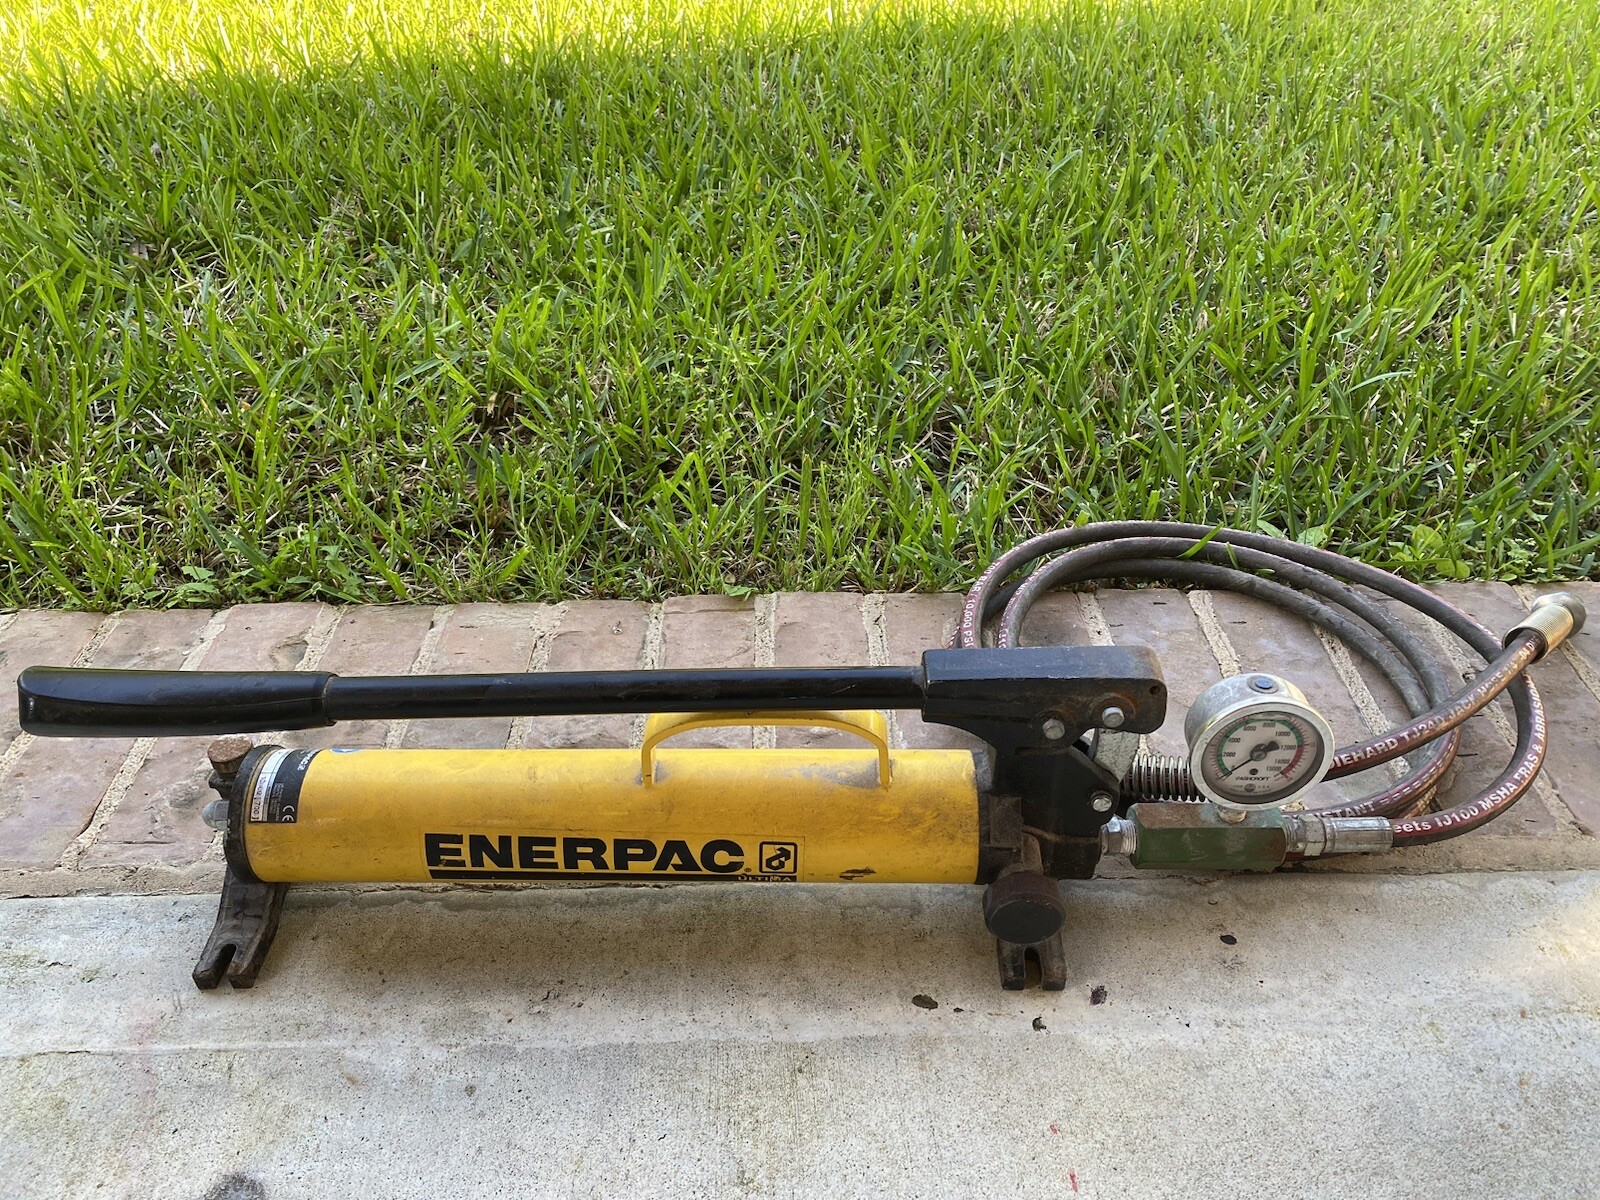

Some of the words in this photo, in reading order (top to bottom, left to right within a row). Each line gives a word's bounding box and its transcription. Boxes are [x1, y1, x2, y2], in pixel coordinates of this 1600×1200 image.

[972, 575, 988, 592] BAR
[1478, 781, 1519, 812] MSHA
[1513, 752, 1540, 784] FRAS
[424, 833, 745, 873] ENERPAC
